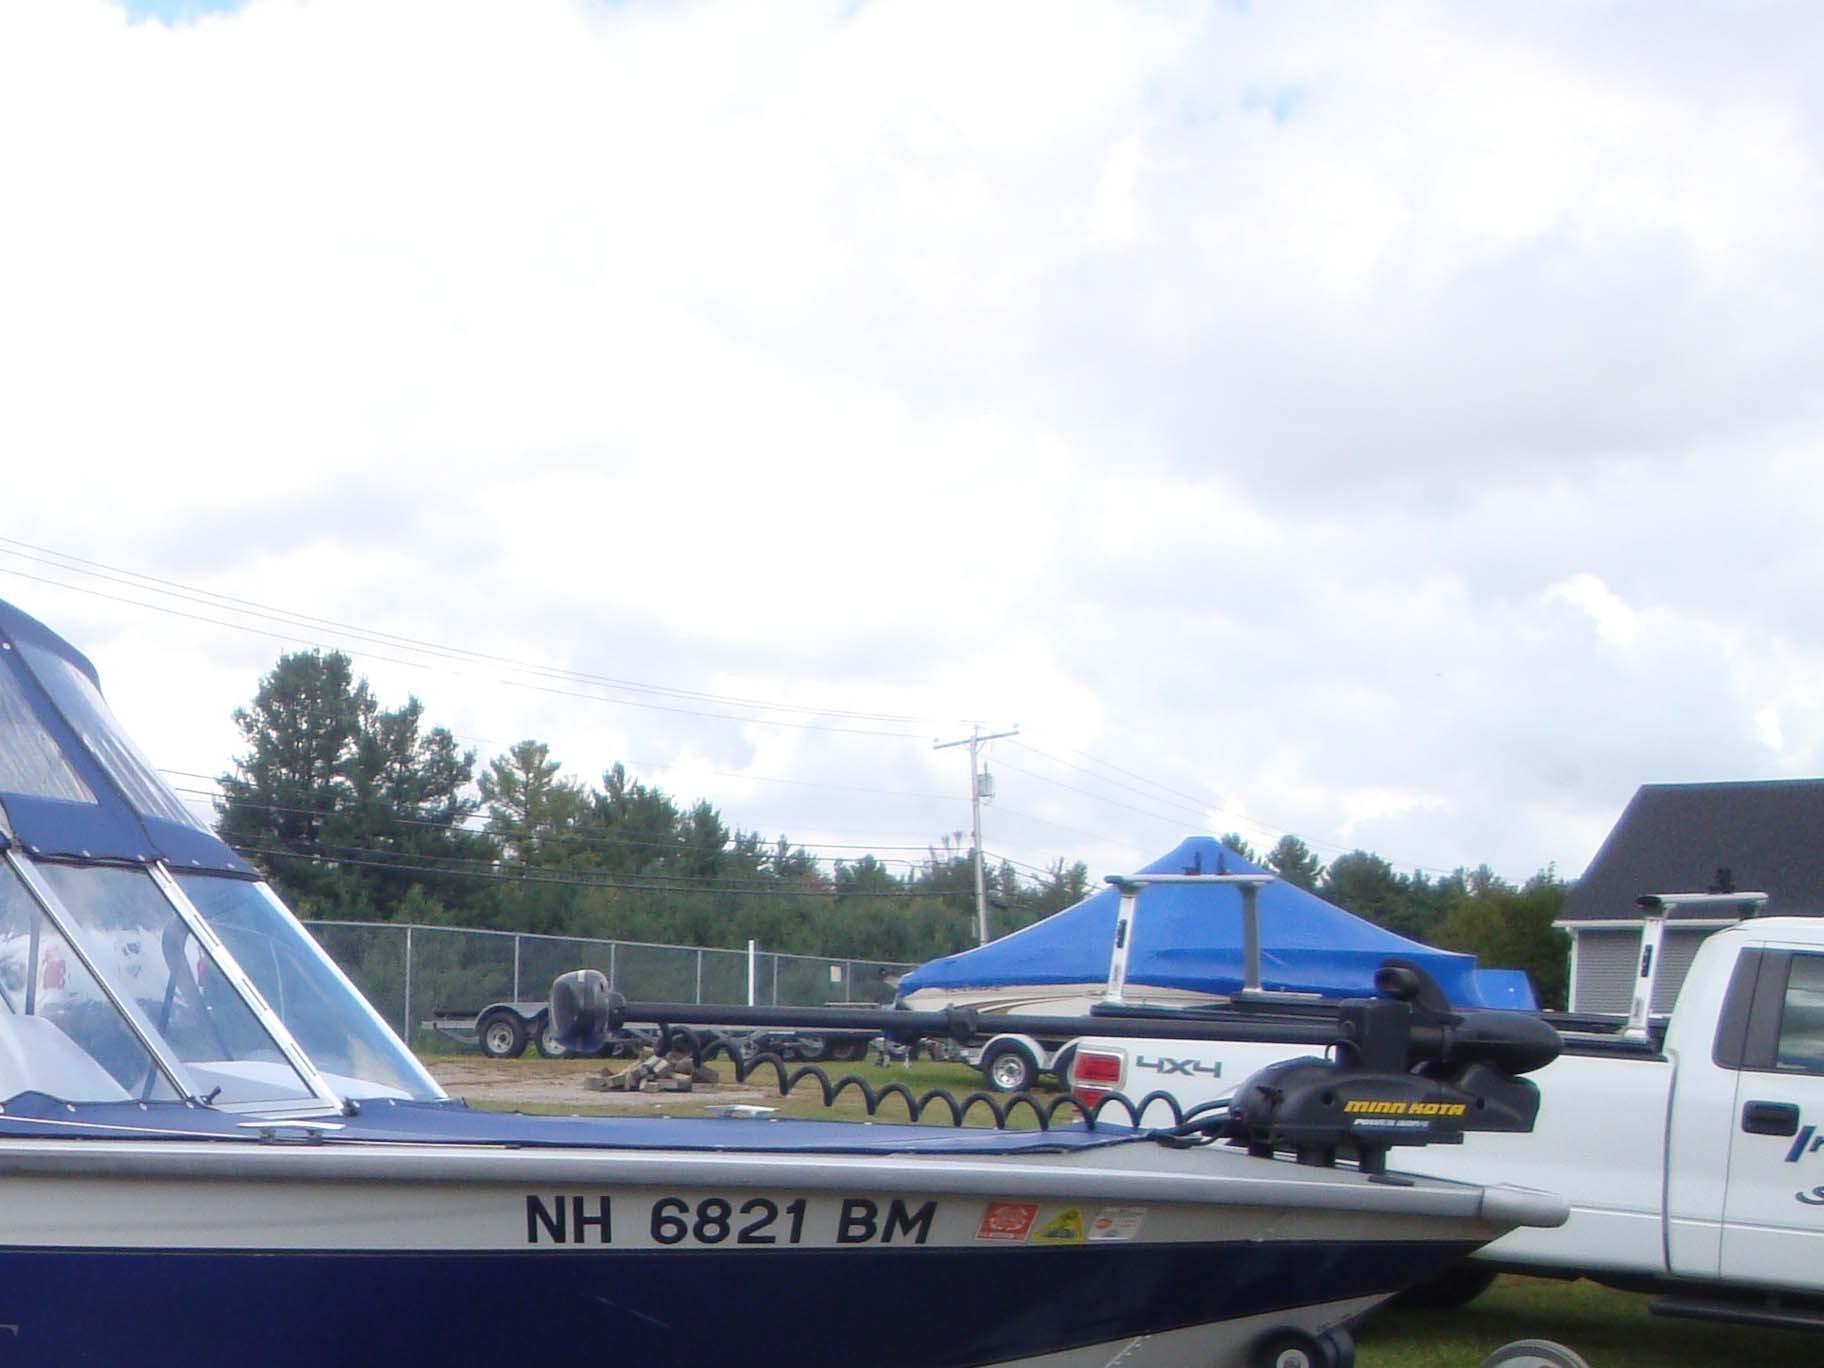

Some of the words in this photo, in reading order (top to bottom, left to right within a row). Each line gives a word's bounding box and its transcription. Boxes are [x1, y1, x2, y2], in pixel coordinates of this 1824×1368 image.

[526, 1195, 612, 1244] NH
[649, 1198, 805, 1244] 6821
[836, 1201, 939, 1244] BM
